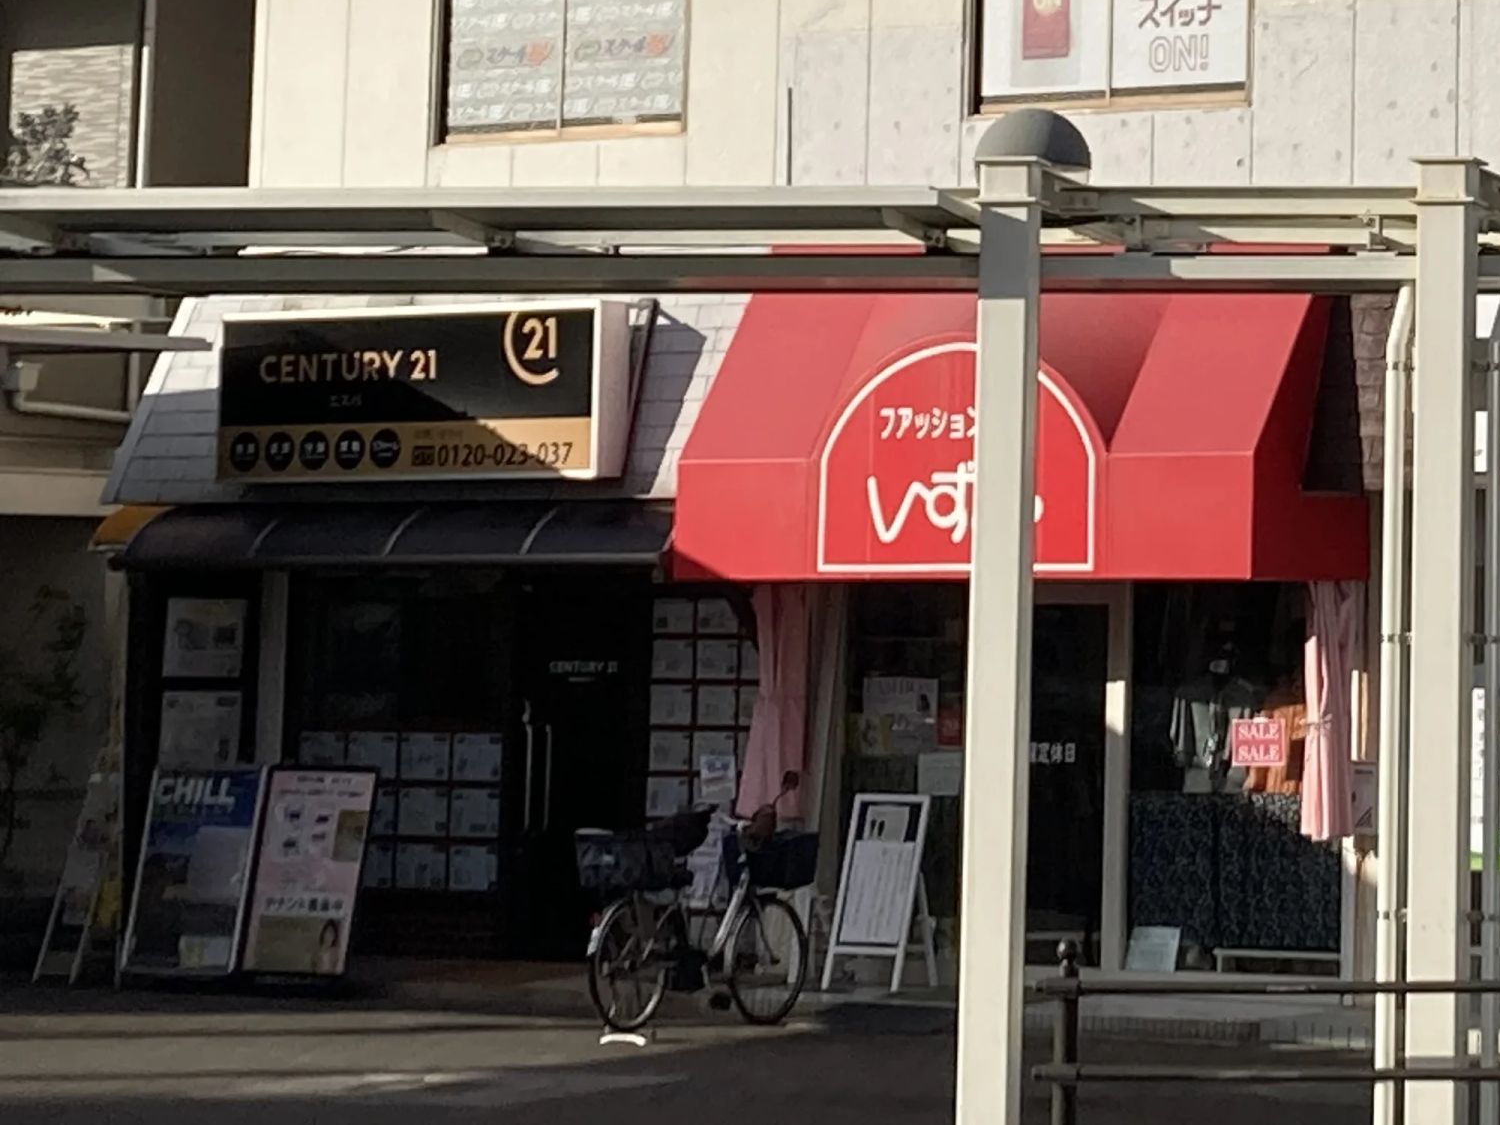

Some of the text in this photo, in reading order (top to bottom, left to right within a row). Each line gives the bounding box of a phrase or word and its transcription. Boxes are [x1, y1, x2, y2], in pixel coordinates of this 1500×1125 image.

[1150, 34, 1210, 73] ON!
[259, 350, 437, 383] CENTURY 21
[437, 441, 573, 467] 0120-023-037
[867, 460, 1043, 543] いず
[1238, 723, 1279, 740] SALE
[1238, 744, 1279, 761] SALE
[158, 776, 237, 807] CHILL
